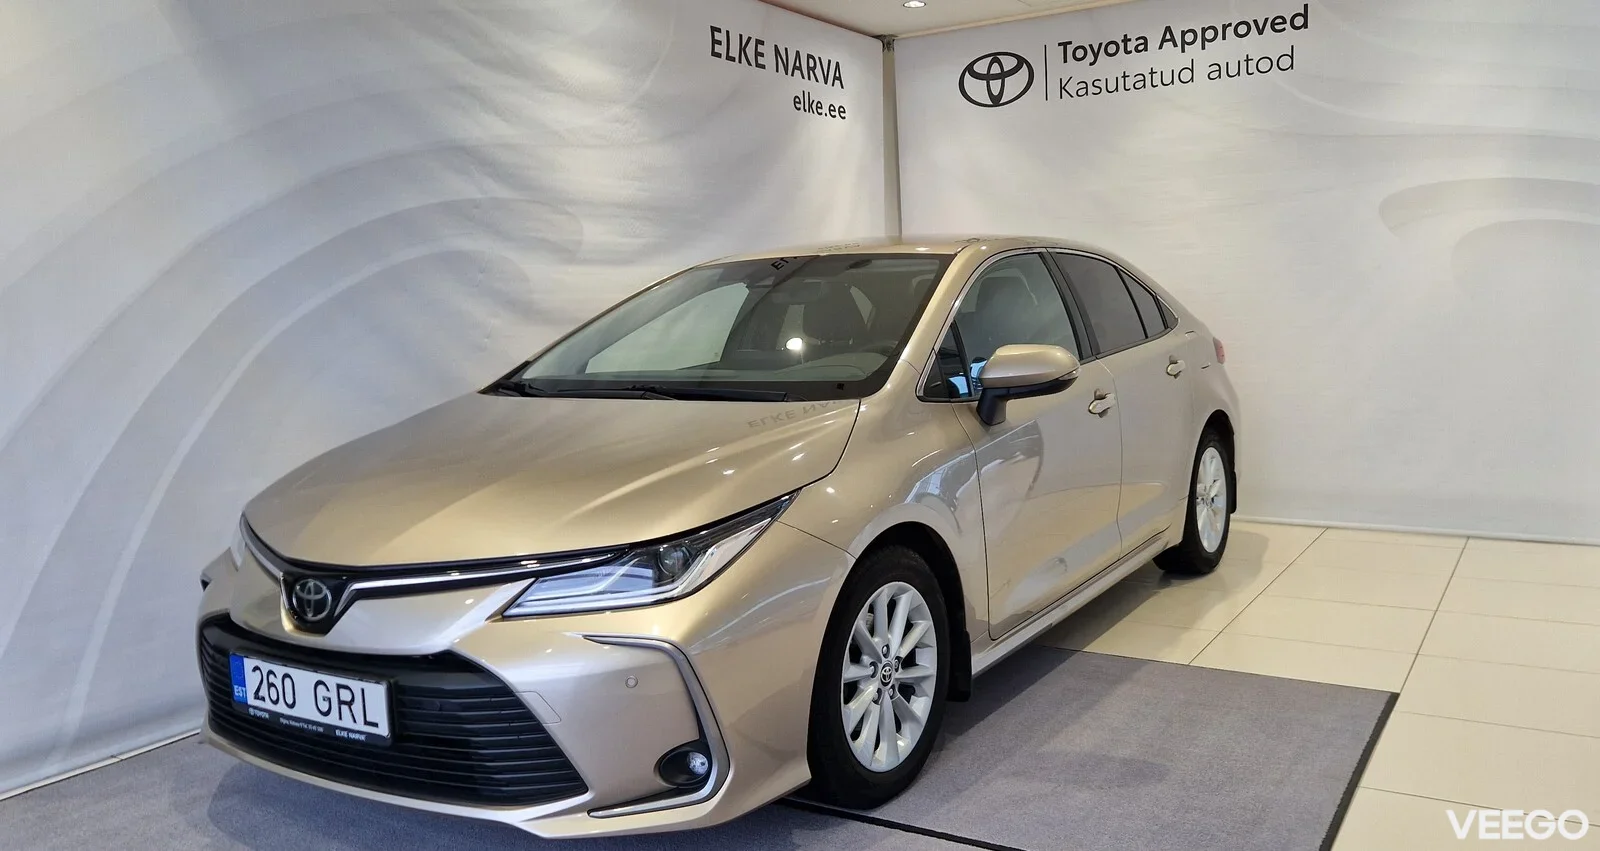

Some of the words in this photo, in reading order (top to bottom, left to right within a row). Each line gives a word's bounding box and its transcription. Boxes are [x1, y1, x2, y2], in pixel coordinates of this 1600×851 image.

[710, 25, 766, 70] ELKE
[774, 44, 845, 90] NARVA
[1058, 33, 1149, 66] Toyota
[1158, 4, 1309, 53] Approved
[1059, 59, 1195, 100] Kasutatud
[1207, 45, 1295, 80] autod
[793, 90, 847, 120] elke.ee
[234, 685, 247, 699] EST
[252, 665, 296, 709] 260
[313, 680, 379, 728] GRL
